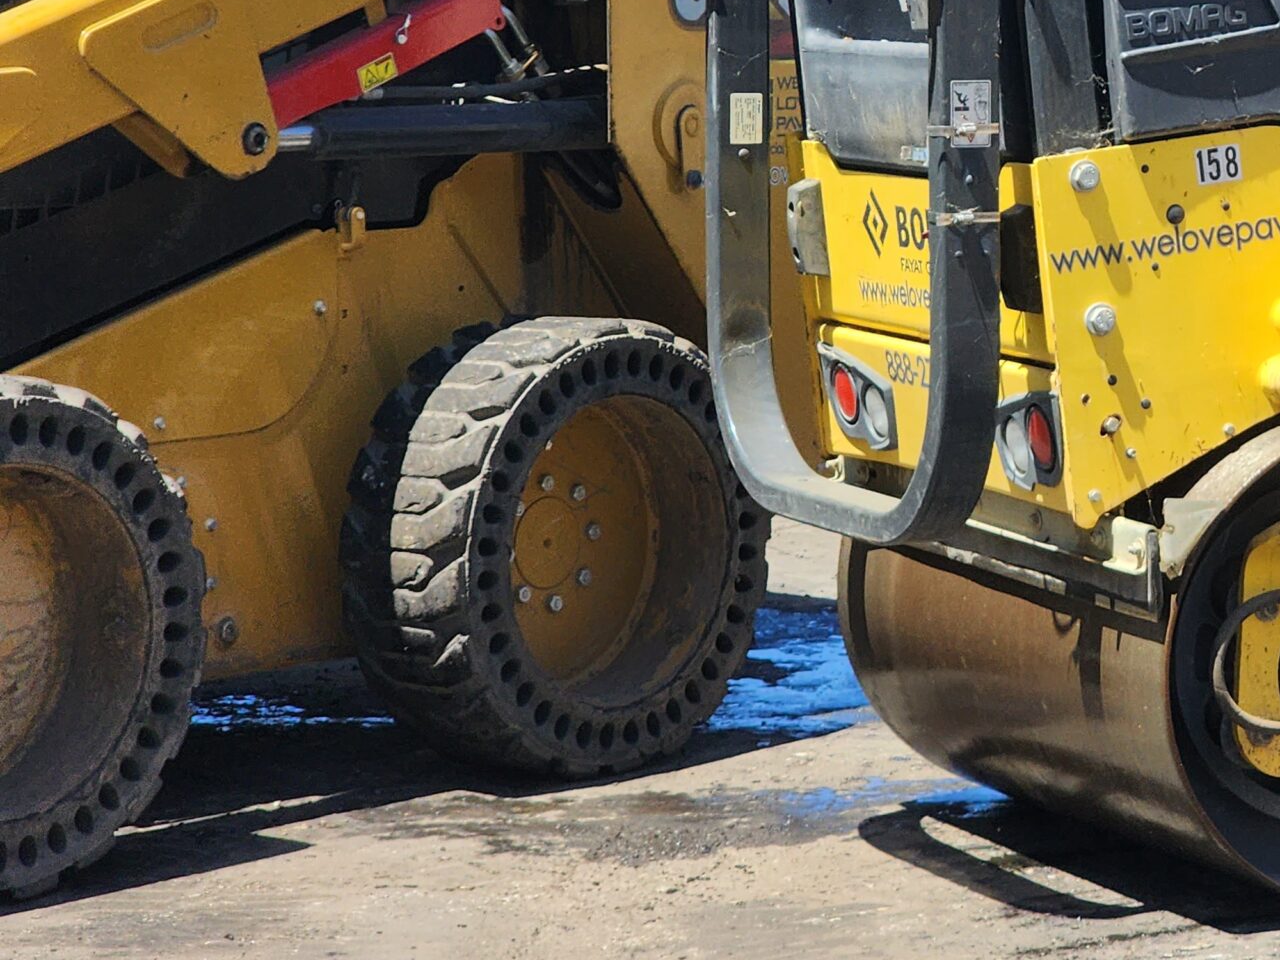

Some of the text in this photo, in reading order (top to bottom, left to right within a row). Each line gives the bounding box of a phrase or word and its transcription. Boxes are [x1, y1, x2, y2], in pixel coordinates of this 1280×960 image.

[1125, 1, 1247, 40] BOMAG
[1197, 145, 1239, 182] 158
[900, 257, 923, 273] FAYAT
[860, 277, 931, 309] www.welove
